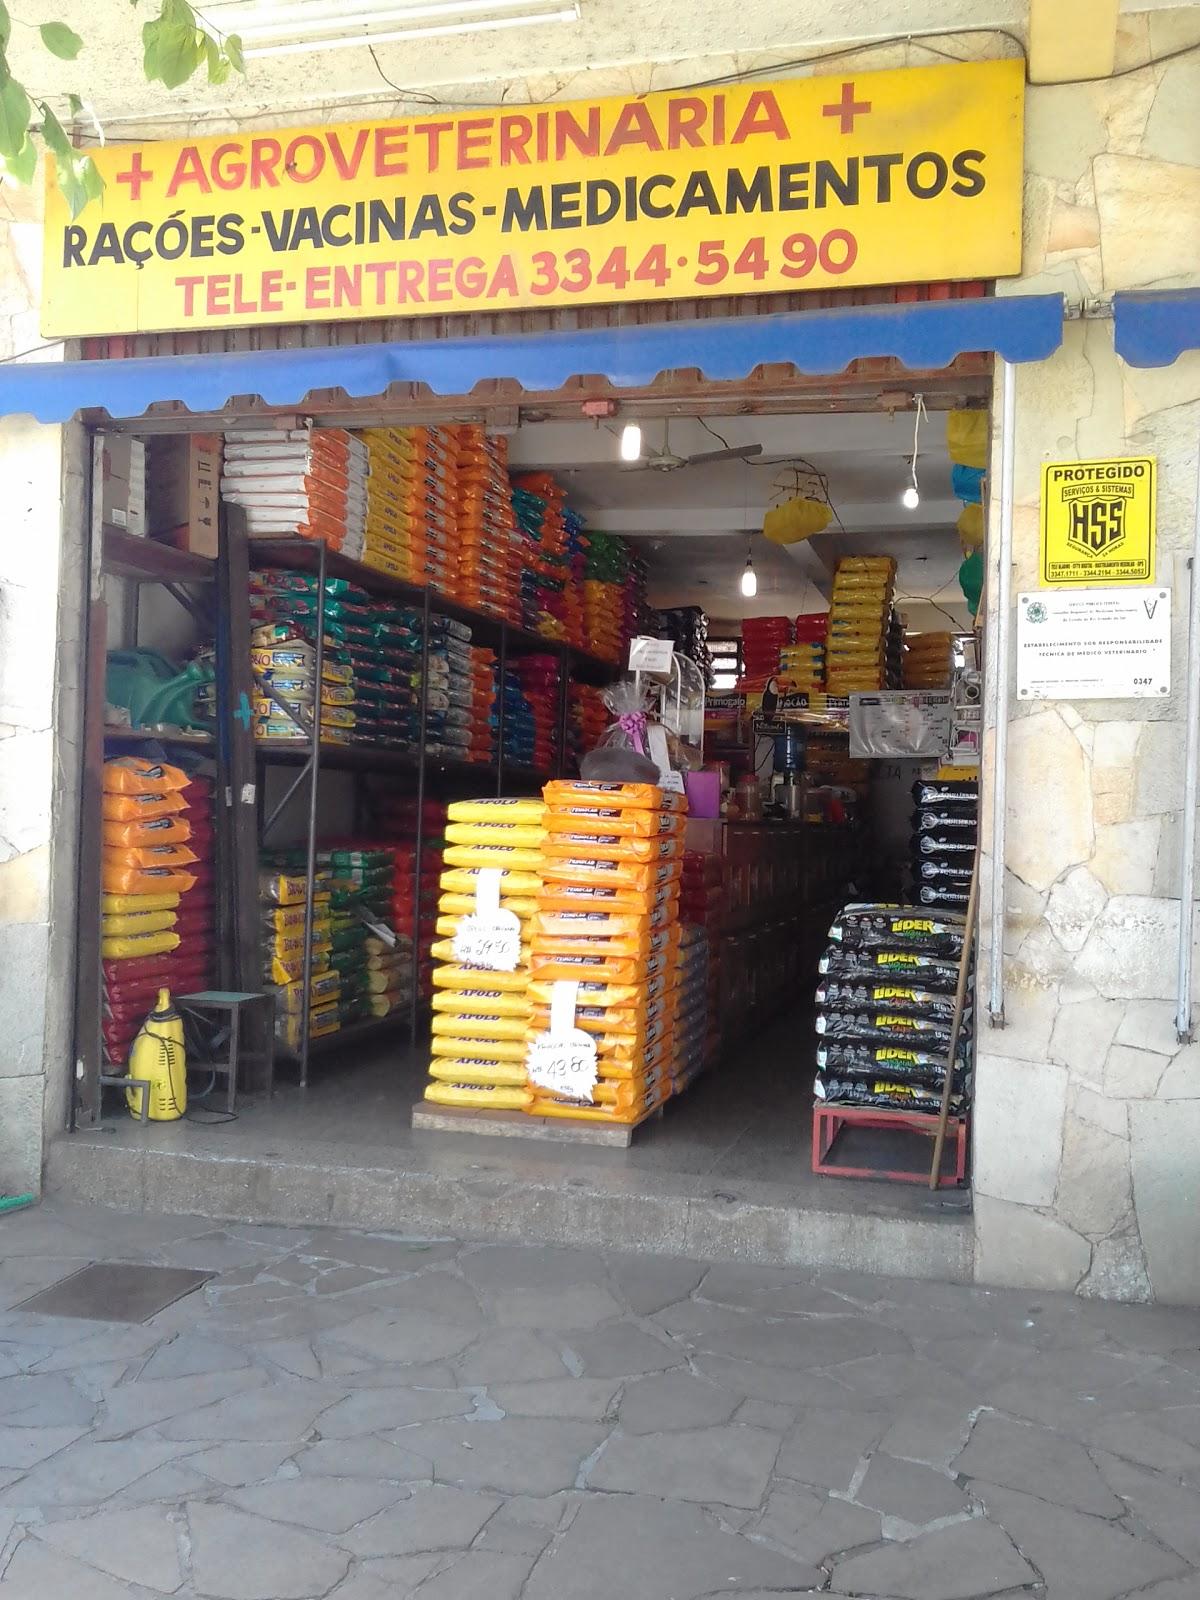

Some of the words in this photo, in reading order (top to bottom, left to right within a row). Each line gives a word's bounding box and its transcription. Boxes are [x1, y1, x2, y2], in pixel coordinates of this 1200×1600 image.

[166, 90, 790, 198] AGROVETERINÁRIA
[1054, 466, 1144, 481] PROTEGIDO
[1064, 486, 1094, 497] SERVIÇOS
[1102, 485, 1132, 494] SISTEMAS
[1072, 500, 1123, 551] HSS
